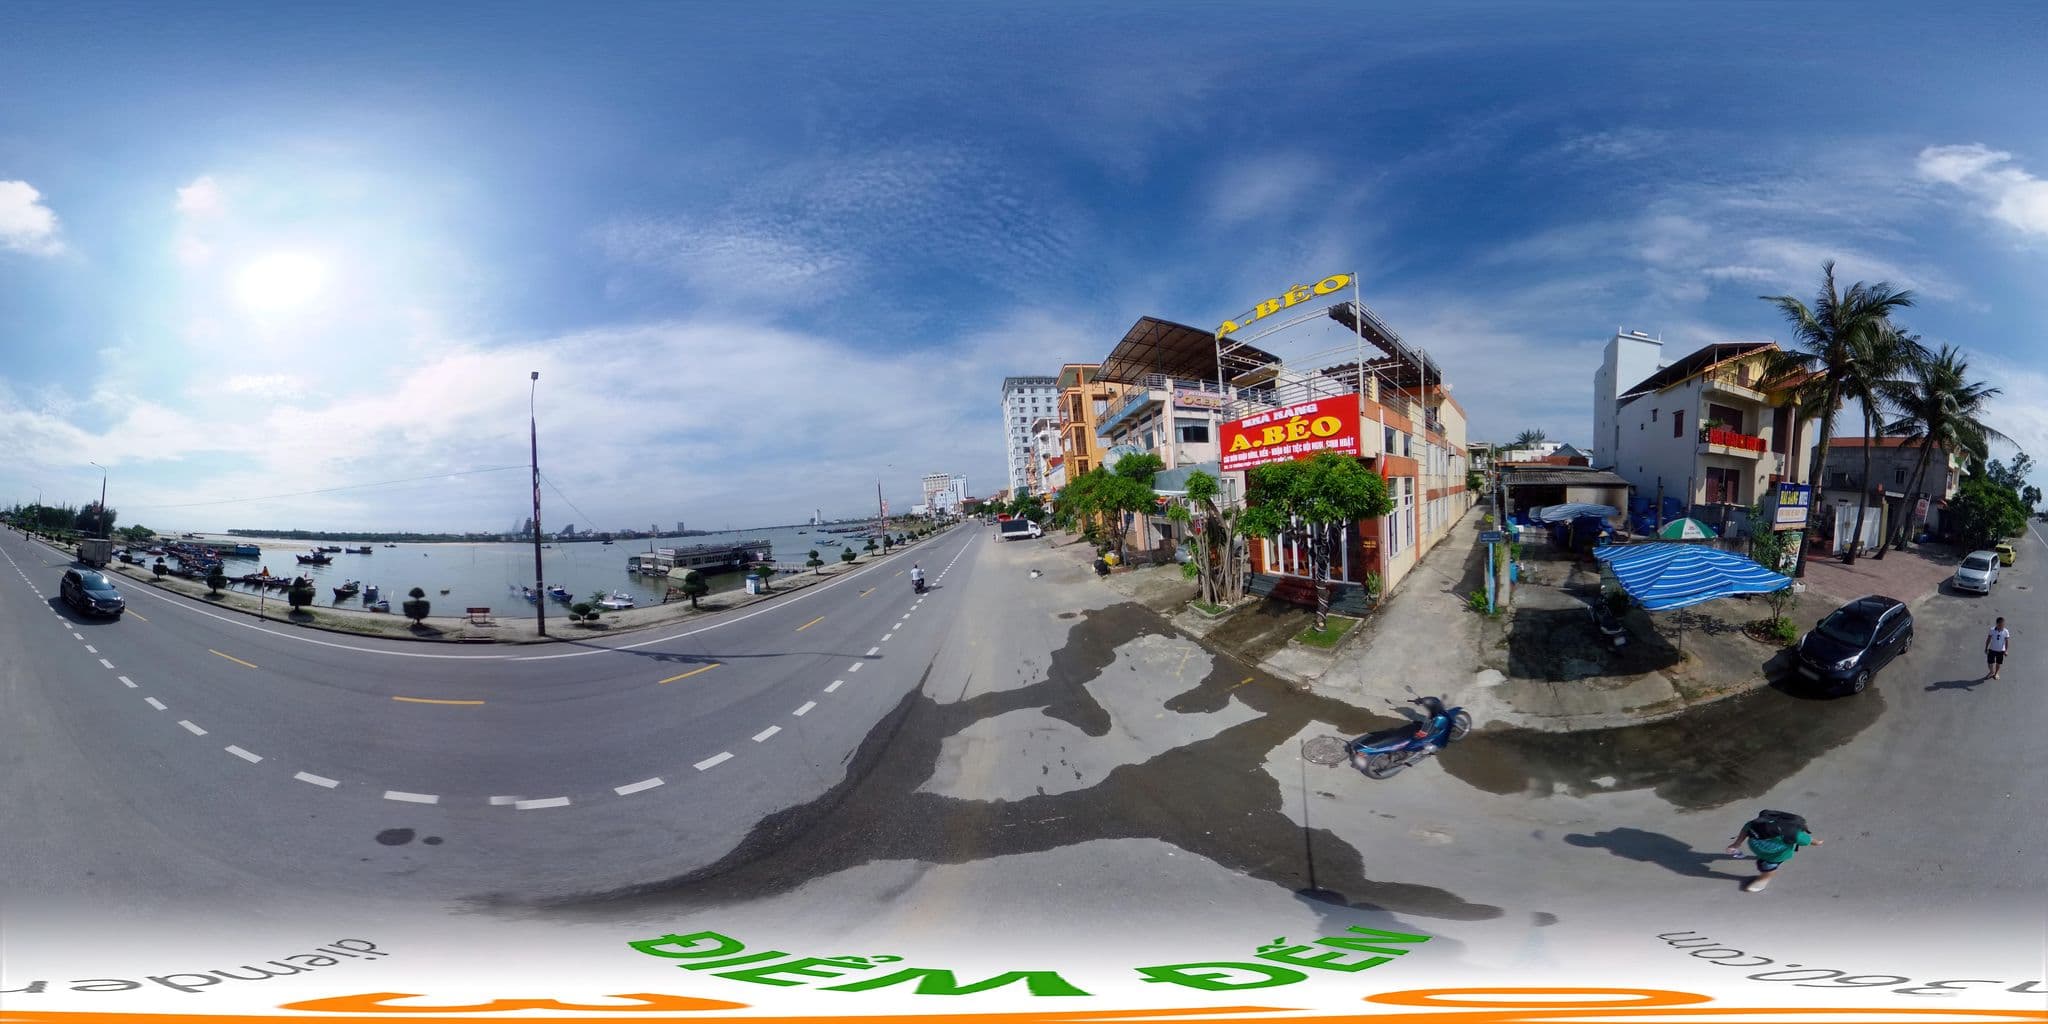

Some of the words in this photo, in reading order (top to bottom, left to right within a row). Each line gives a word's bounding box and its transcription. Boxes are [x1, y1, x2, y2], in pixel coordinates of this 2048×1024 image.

[1218, 273, 1351, 339] A.BÉO
[1229, 415, 1342, 452] A.BÉO
[1242, 411, 1270, 428] NHÀ
[1273, 403, 1318, 420] HÀNG
